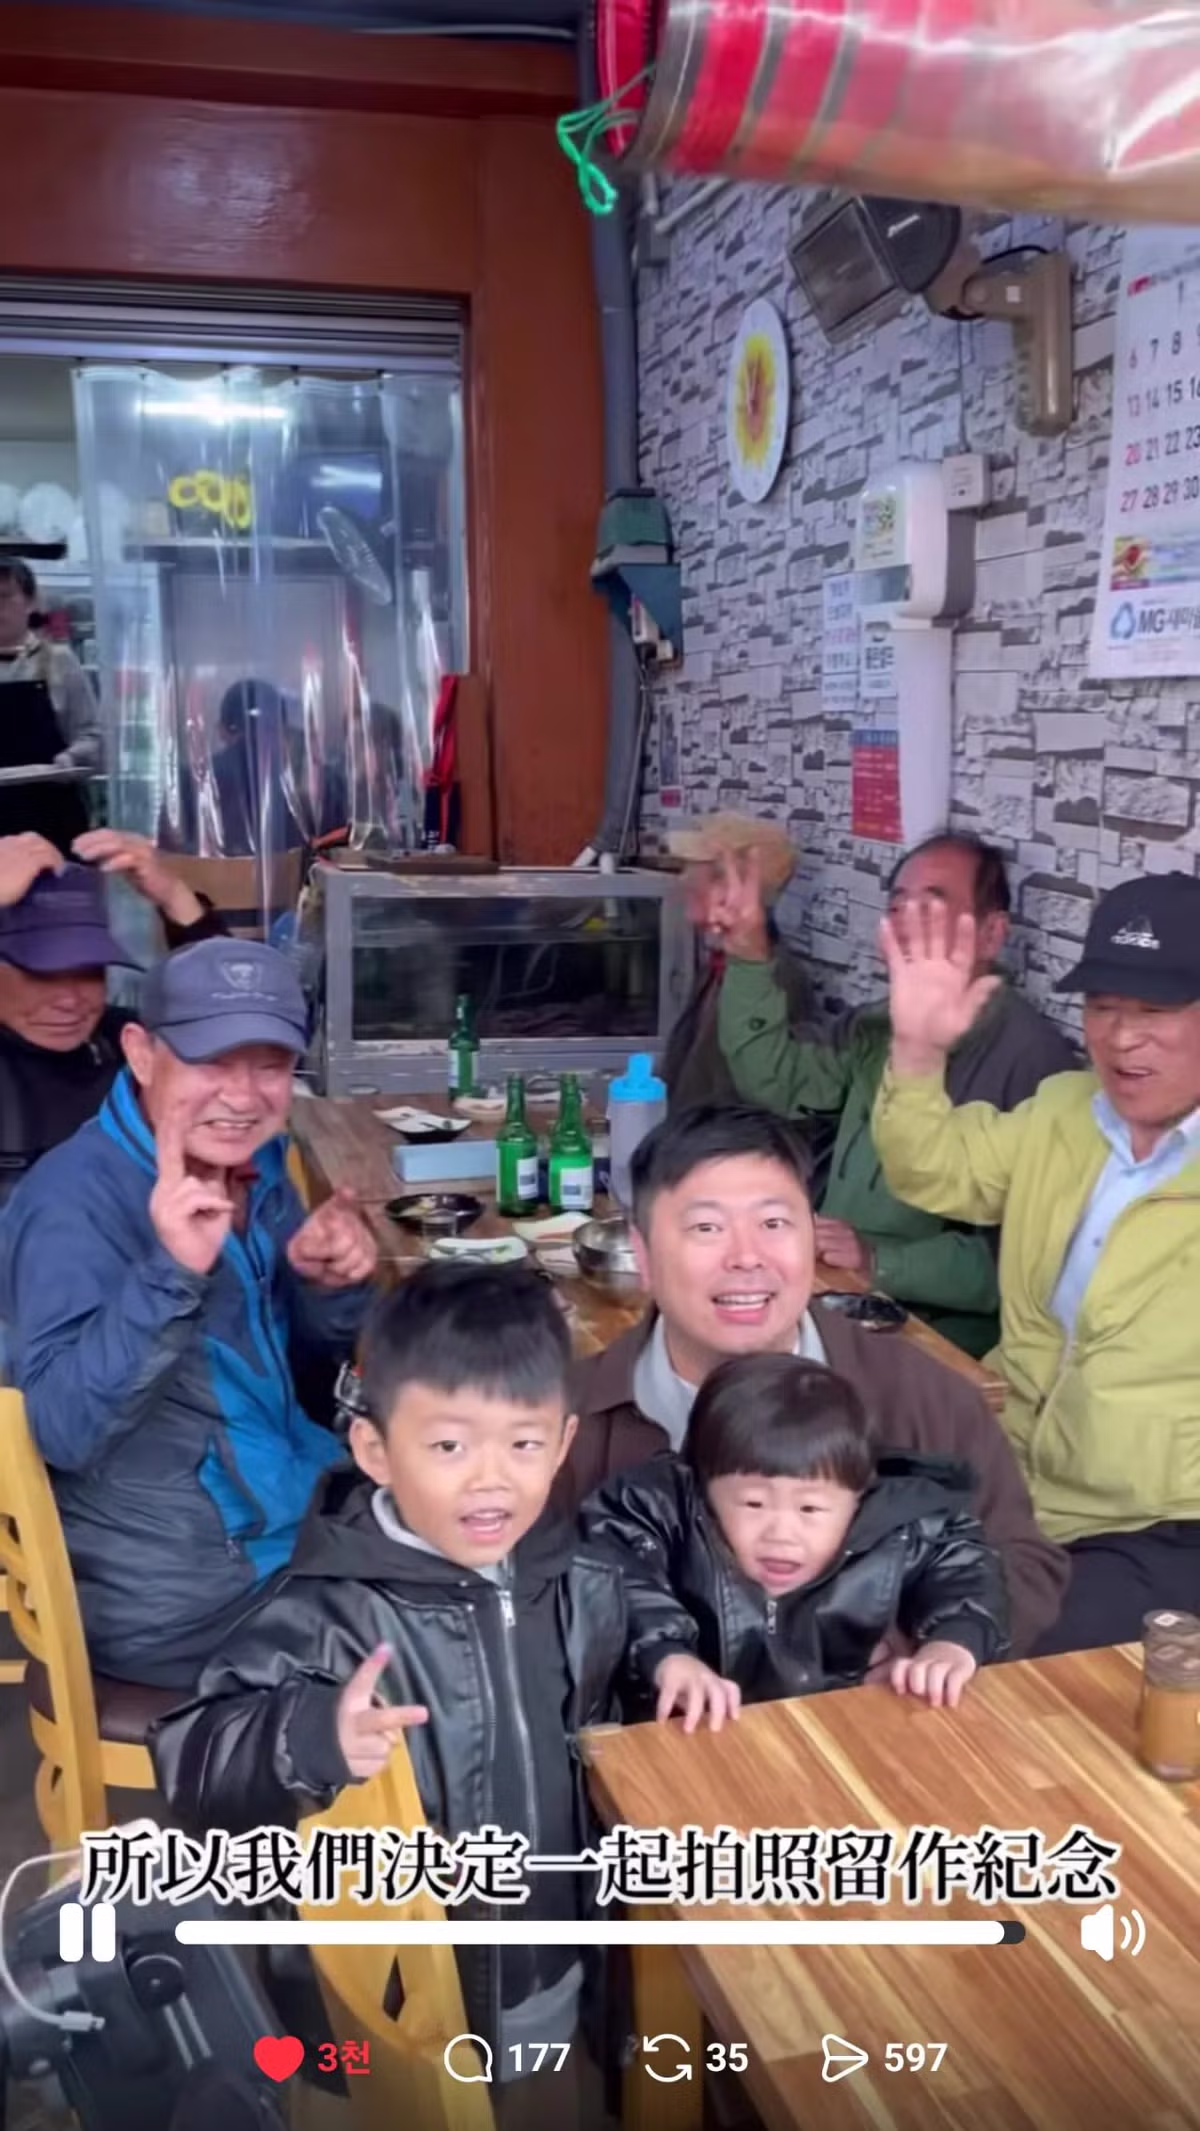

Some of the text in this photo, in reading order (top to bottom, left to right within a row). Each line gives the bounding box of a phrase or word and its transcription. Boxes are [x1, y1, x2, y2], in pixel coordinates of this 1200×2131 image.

[1149, 337, 1160, 362] 7
[1171, 330, 1182, 355] 8
[1145, 386, 1160, 413] 14
[1167, 378, 1183, 407] 15
[1125, 424, 1200, 467] 20 21 22 23
[1120, 474, 1200, 513] 27 28 29 30
